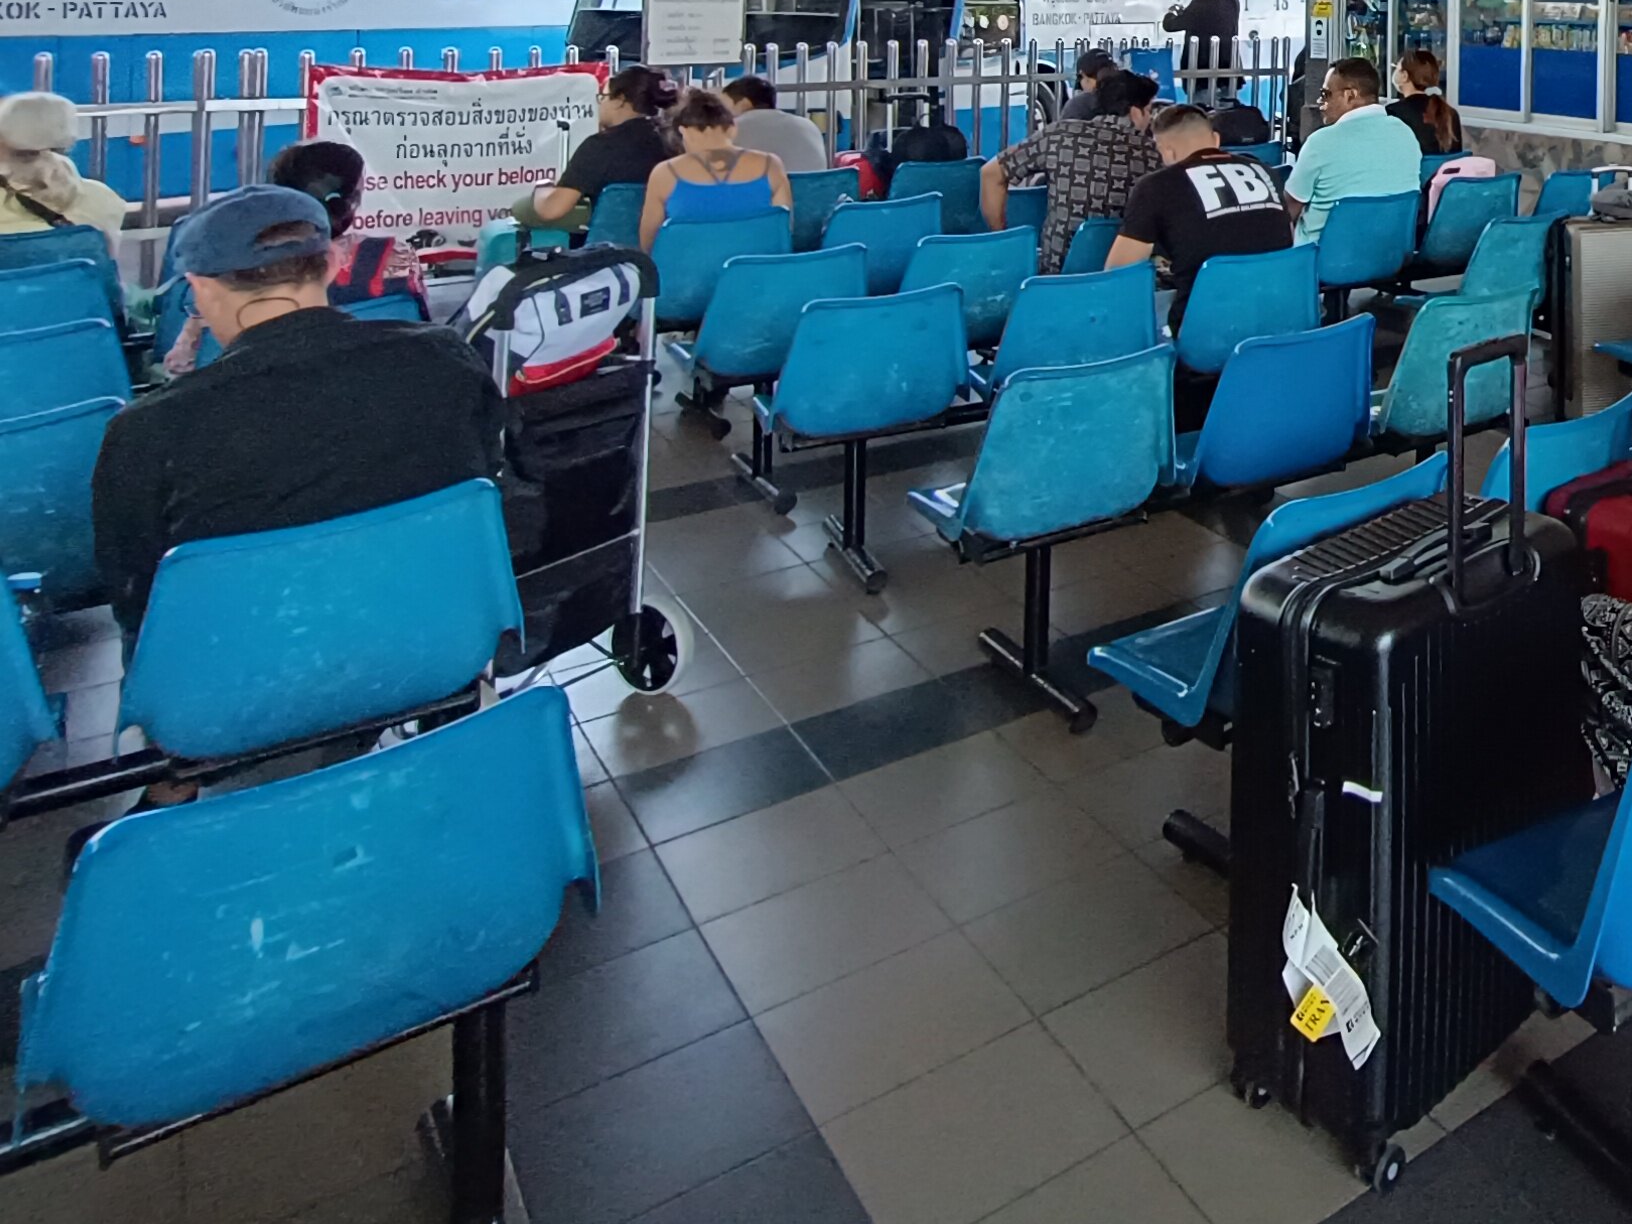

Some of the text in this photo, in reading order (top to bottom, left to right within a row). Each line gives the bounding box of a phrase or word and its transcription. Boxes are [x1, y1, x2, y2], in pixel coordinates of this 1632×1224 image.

[62, 1, 168, 20] PATTAYA
[1032, 12, 1078, 26] BANGKOK
[395, 126, 533, 167] ก่อนลุกจากที่นั่ง
[393, 169, 447, 190] check
[451, 172, 494, 193] your
[352, 208, 413, 230] before
[419, 205, 483, 228] leaving
